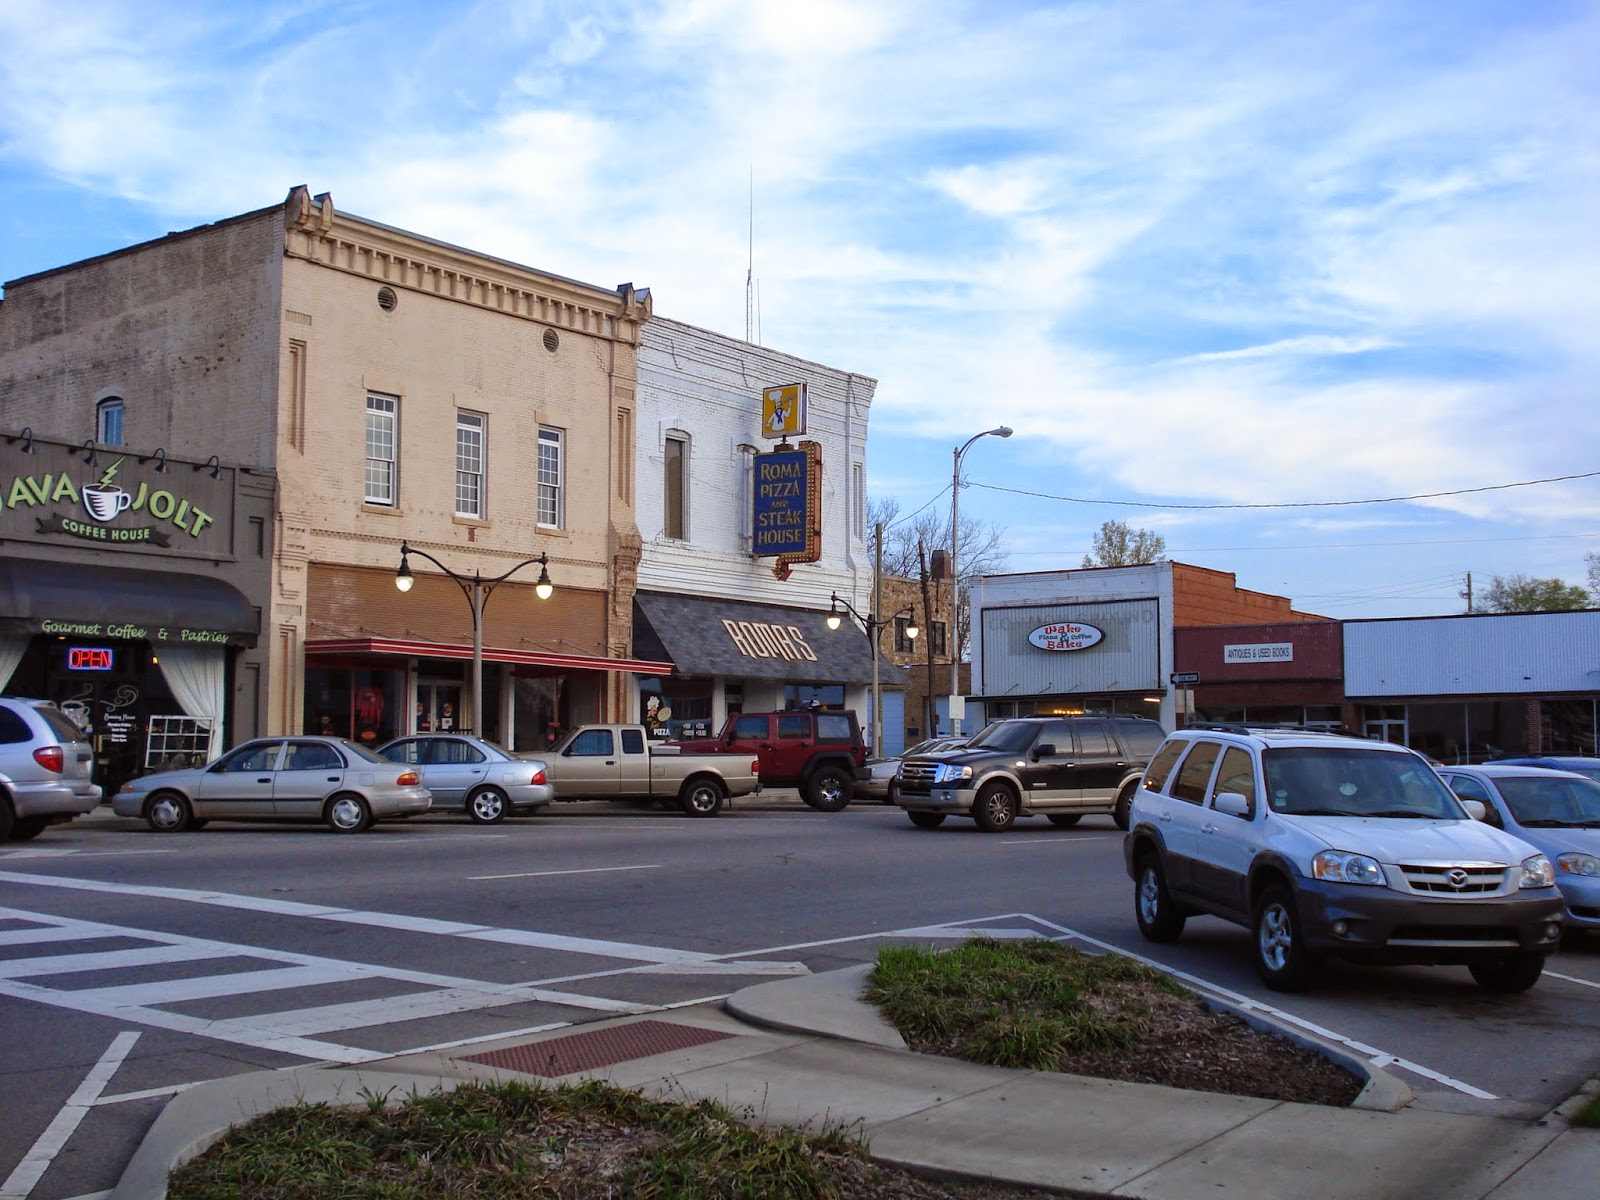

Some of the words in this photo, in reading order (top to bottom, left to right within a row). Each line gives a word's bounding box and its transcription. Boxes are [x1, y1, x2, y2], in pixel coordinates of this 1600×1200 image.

[761, 462, 802, 481] ROMA
[760, 480, 801, 499] PIZZA
[0, 472, 80, 514] AVA
[131, 482, 213, 538] JOLT
[771, 500, 788, 509] AND
[759, 509, 801, 527] STEAK
[62, 518, 107, 540] COFFEE
[111, 528, 150, 541] HOUSE
[758, 528, 803, 546] HOUSE
[42, 619, 102, 636] Gourmet
[106, 623, 147, 639] Coffee
[157, 628, 168, 640] &
[180, 629, 229, 644] Pastries
[1044, 624, 1081, 635] Wake
[1047, 640, 1082, 649] Bake
[1228, 648, 1252, 659] ANTIQUES
[1258, 647, 1272, 658] USED
[1272, 647, 1290, 658] BOOKS
[71, 650, 111, 668] OPEN
[653, 728, 670, 736] PIZZA
